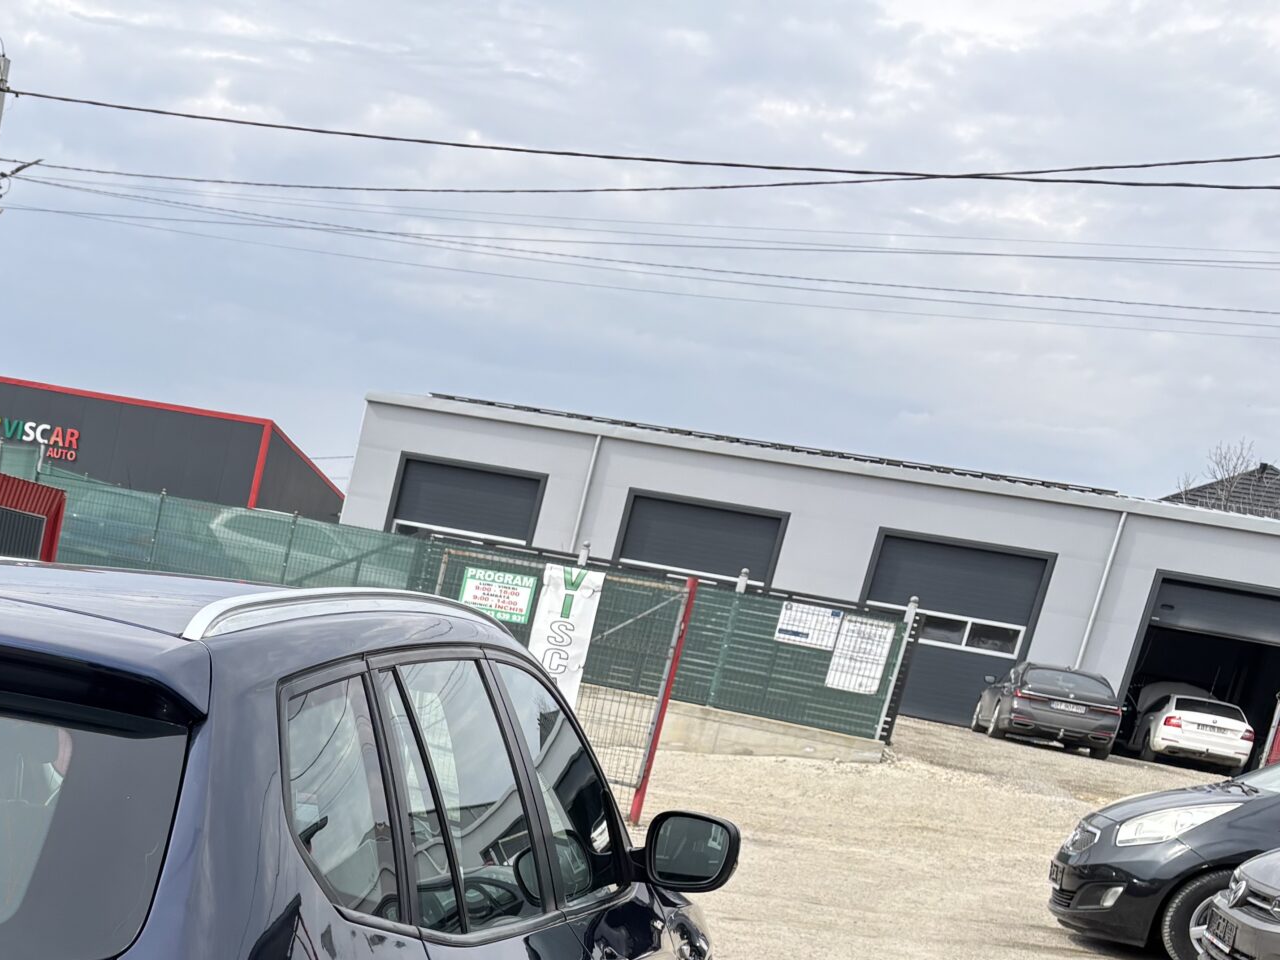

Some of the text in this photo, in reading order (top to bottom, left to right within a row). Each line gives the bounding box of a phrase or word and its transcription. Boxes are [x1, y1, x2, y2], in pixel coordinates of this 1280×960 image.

[3, 417, 80, 449] VISCAR
[46, 447, 76, 460] AUTO
[467, 568, 534, 587] PROGRAM
[542, 566, 589, 686] VISC
